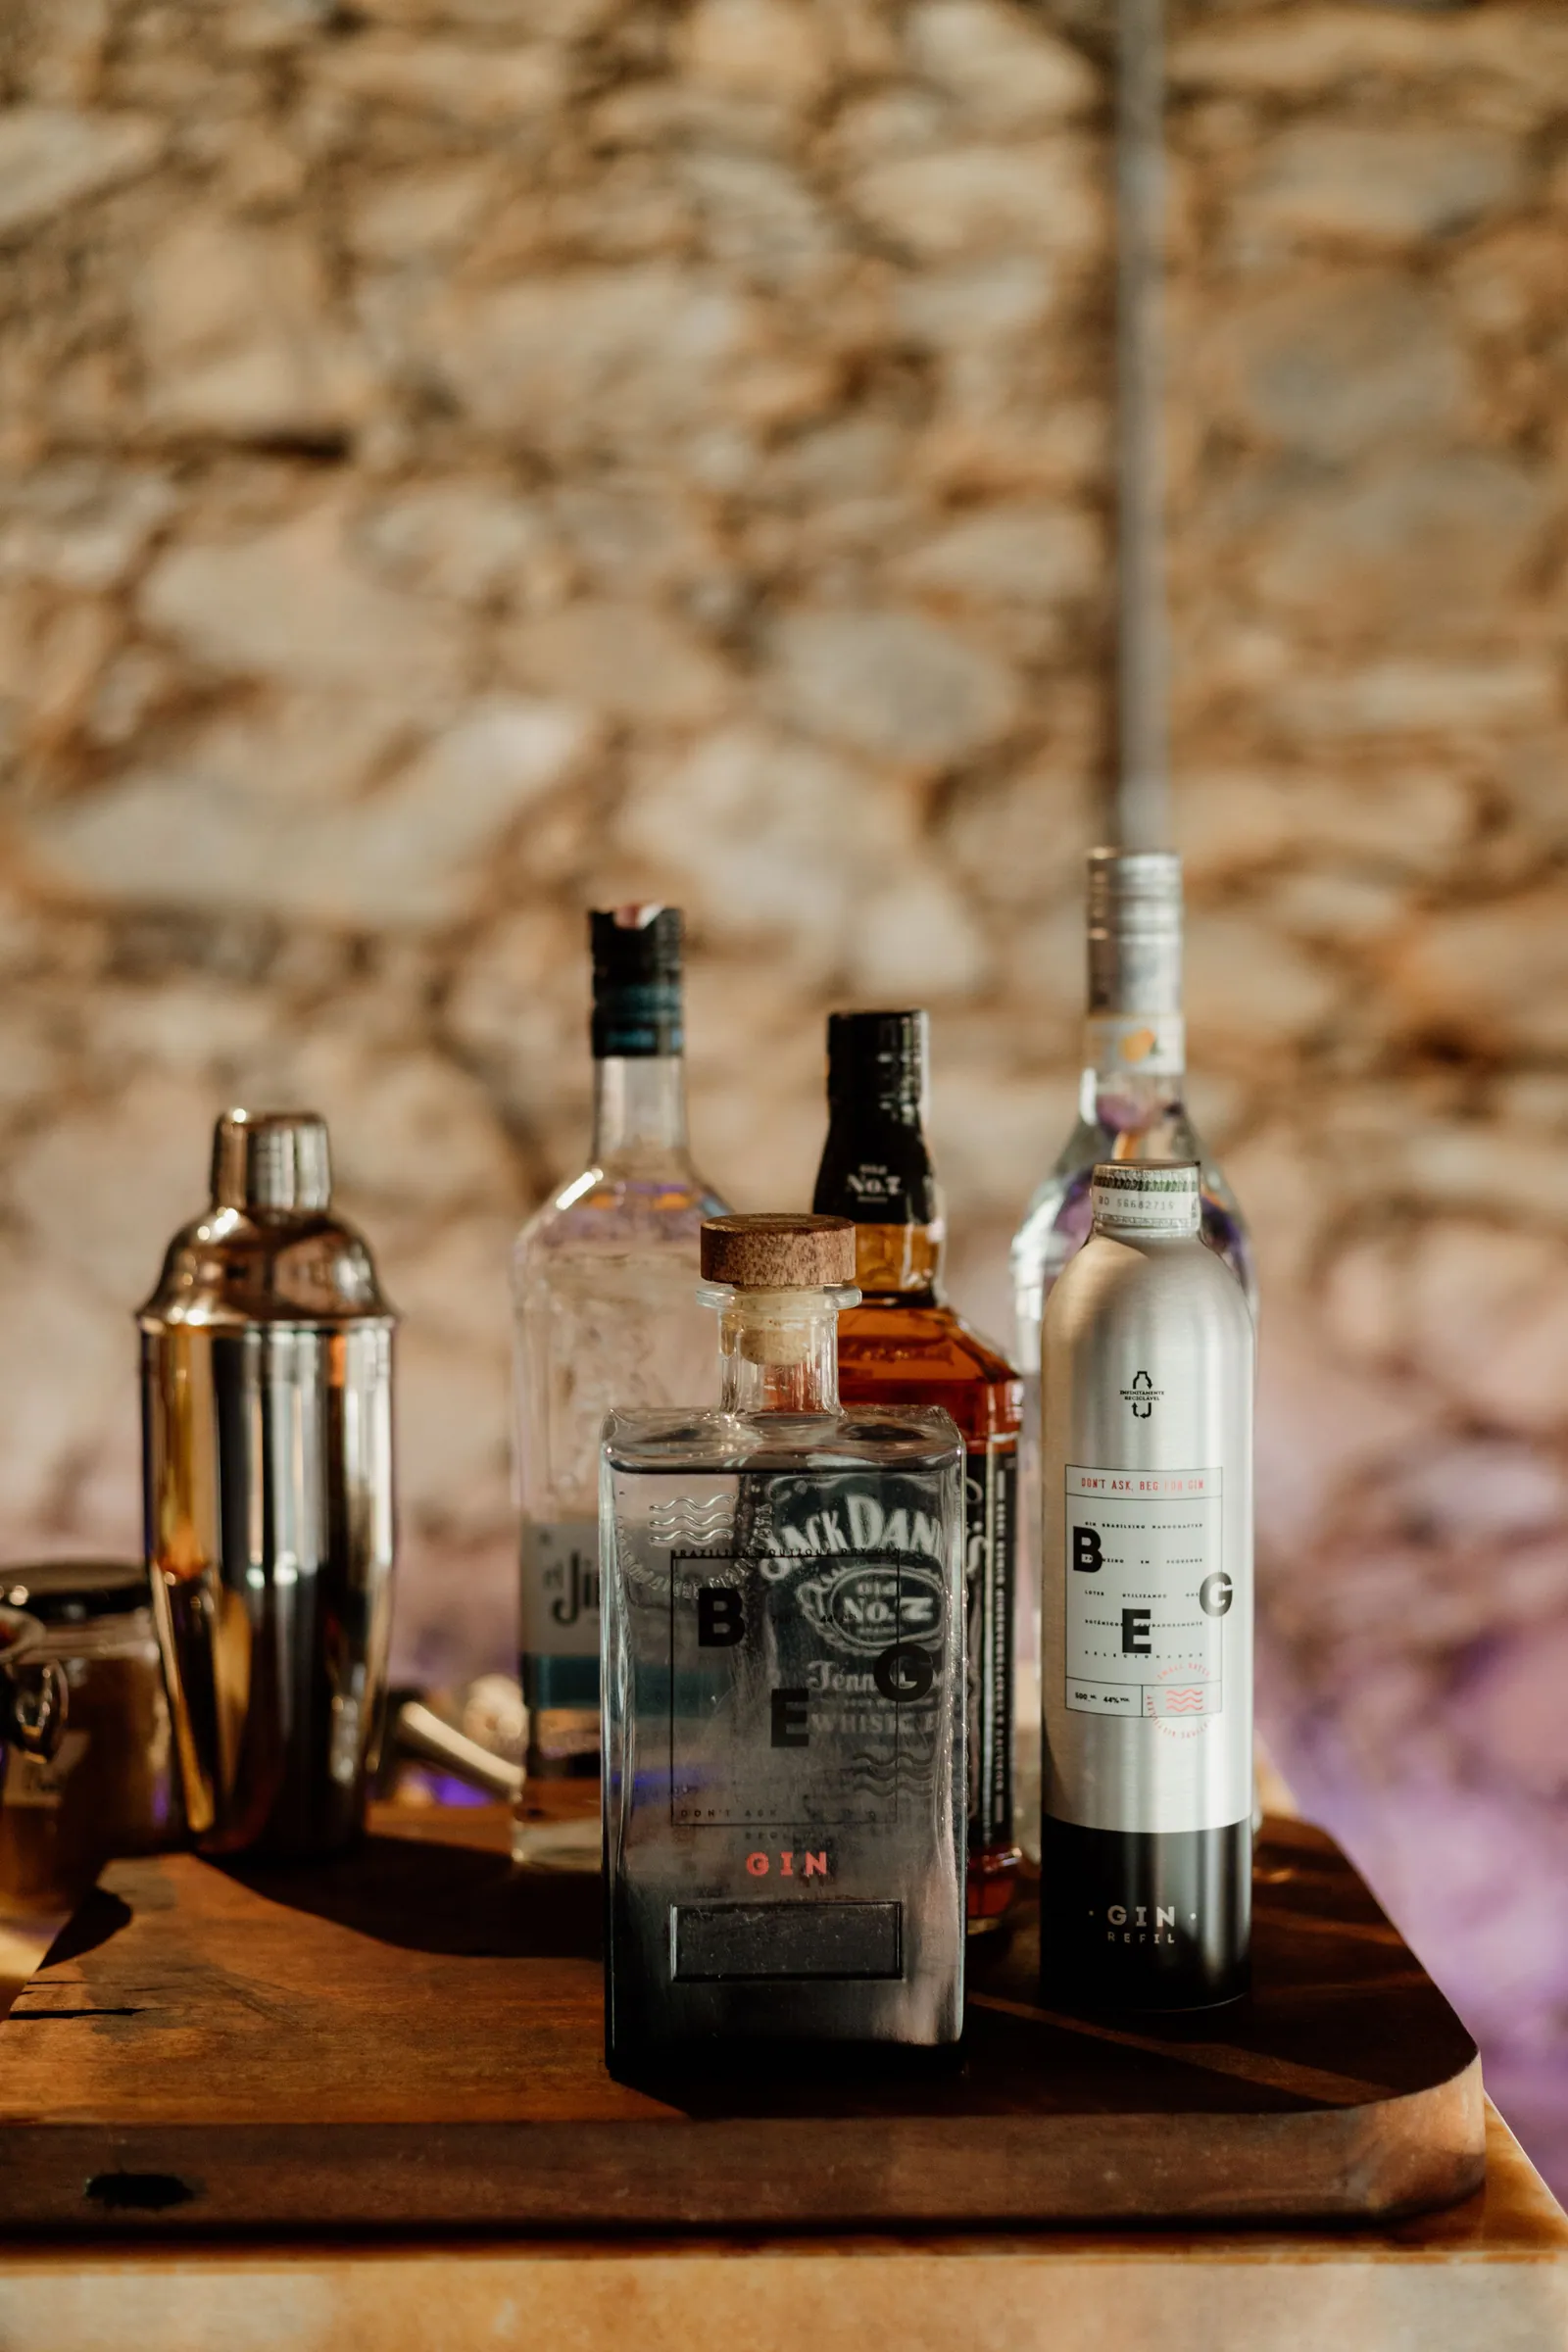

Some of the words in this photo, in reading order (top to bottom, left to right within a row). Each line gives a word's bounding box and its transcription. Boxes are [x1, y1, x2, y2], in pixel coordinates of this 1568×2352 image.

[1081, 1478, 1106, 1489] DON'T
[1140, 1481, 1158, 1491] BEG
[1188, 1478, 1204, 1490] GIN
[746, 1850, 827, 1877] GIN
[1107, 1904, 1175, 1927] GIN
[1107, 1931, 1175, 1944] REFIL
